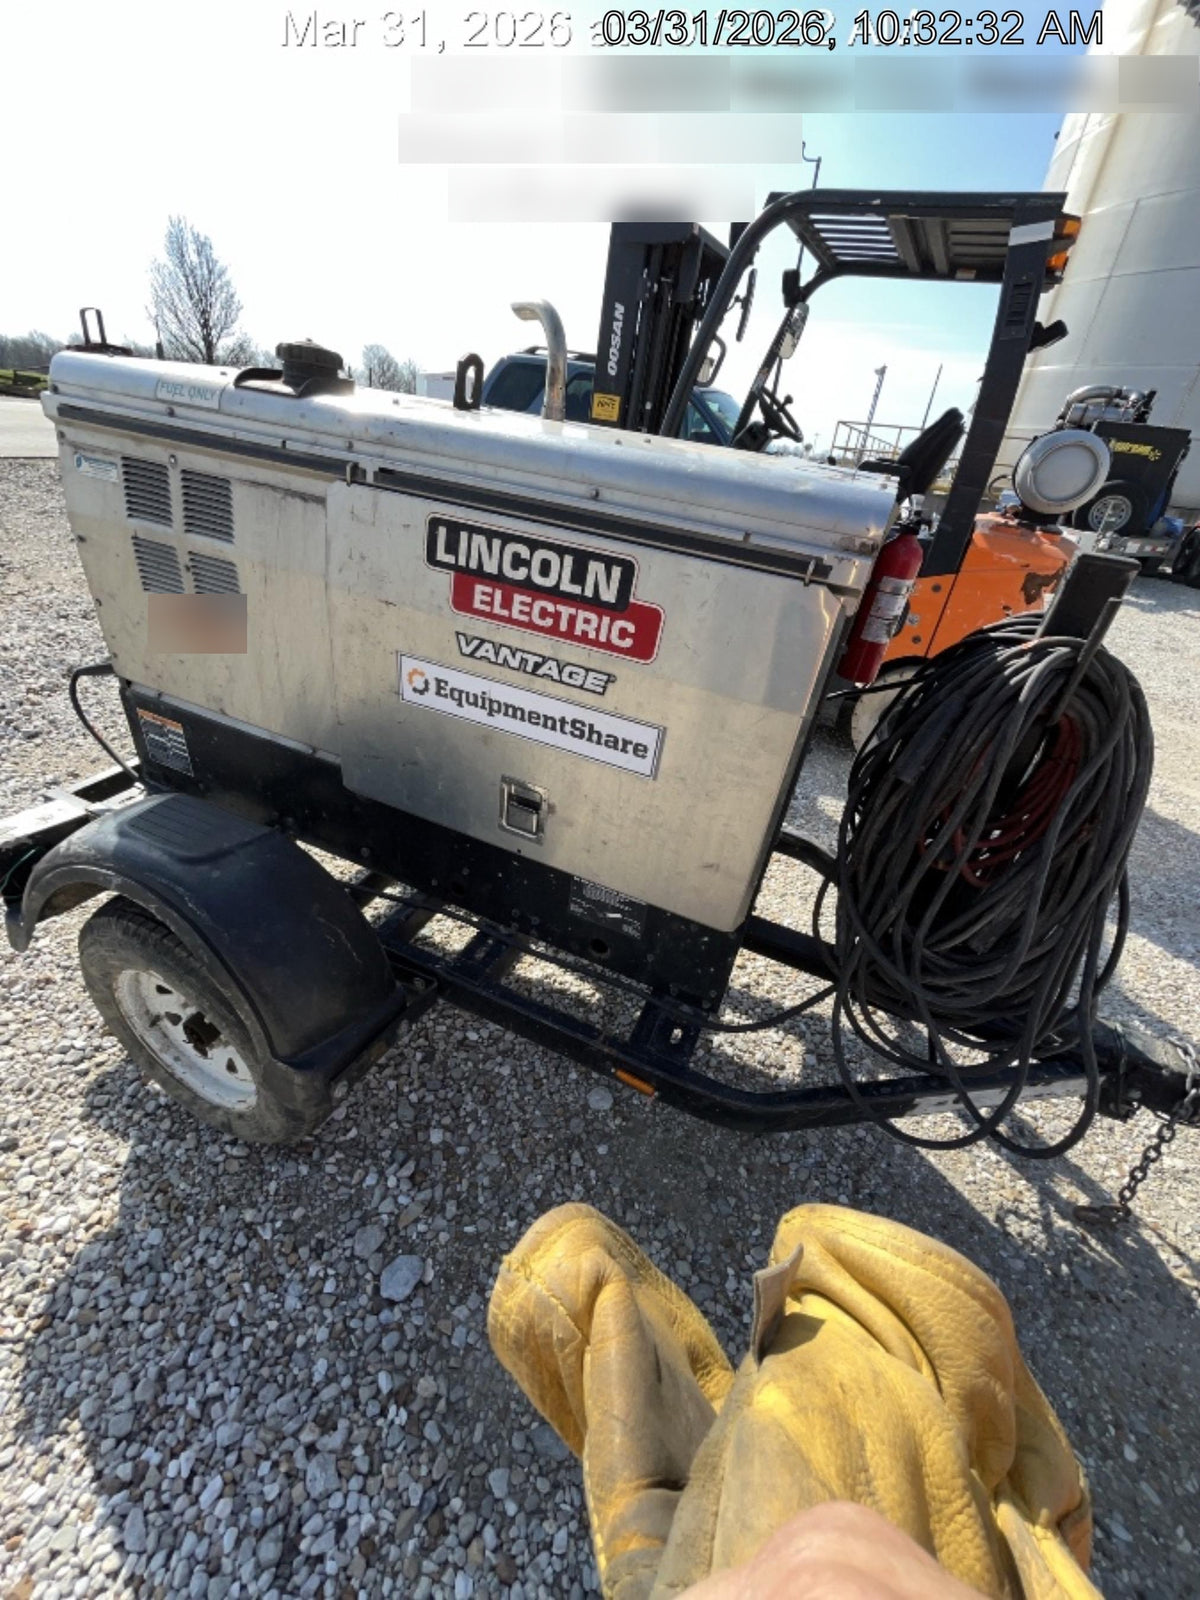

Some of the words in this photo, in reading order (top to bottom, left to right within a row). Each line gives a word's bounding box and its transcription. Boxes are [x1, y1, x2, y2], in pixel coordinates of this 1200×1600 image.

[160, 382, 185, 398] FUEL
[188, 385, 218, 401] ONLY
[435, 525, 622, 604] LINCOLN
[472, 584, 636, 649] ELECTRIC
[455, 630, 612, 696] VANTAGE
[434, 677, 650, 760] EquipmentShare
